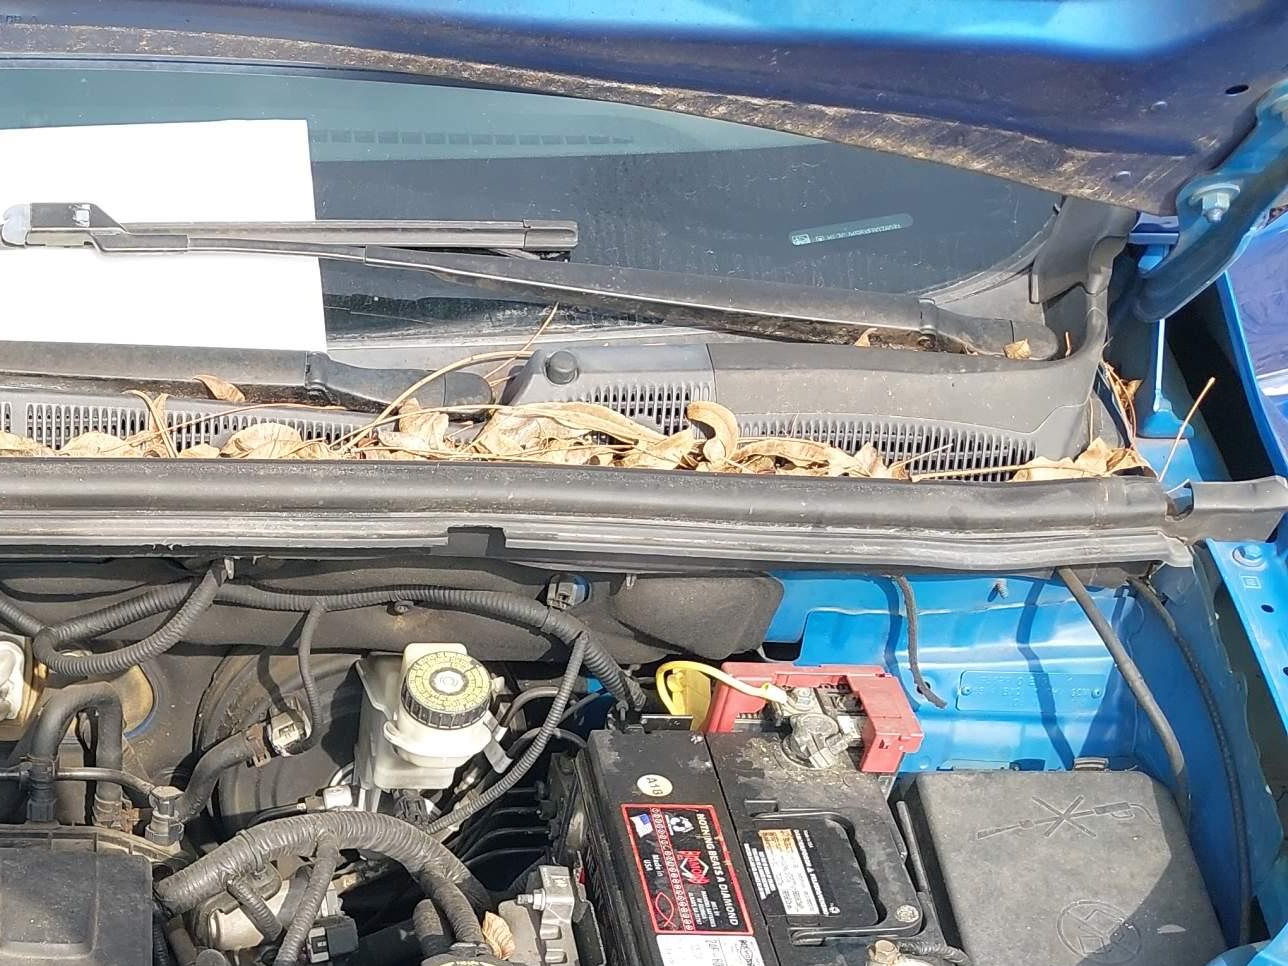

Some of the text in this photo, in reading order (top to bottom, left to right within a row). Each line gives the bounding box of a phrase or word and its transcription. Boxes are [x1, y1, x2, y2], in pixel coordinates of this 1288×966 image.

[642, 859, 653, 871] USA
[650, 854, 663, 869] Made
[696, 813, 714, 849] NOTHING
[706, 850, 723, 876] BEATS
[717, 883, 739, 925] DIAMOND
